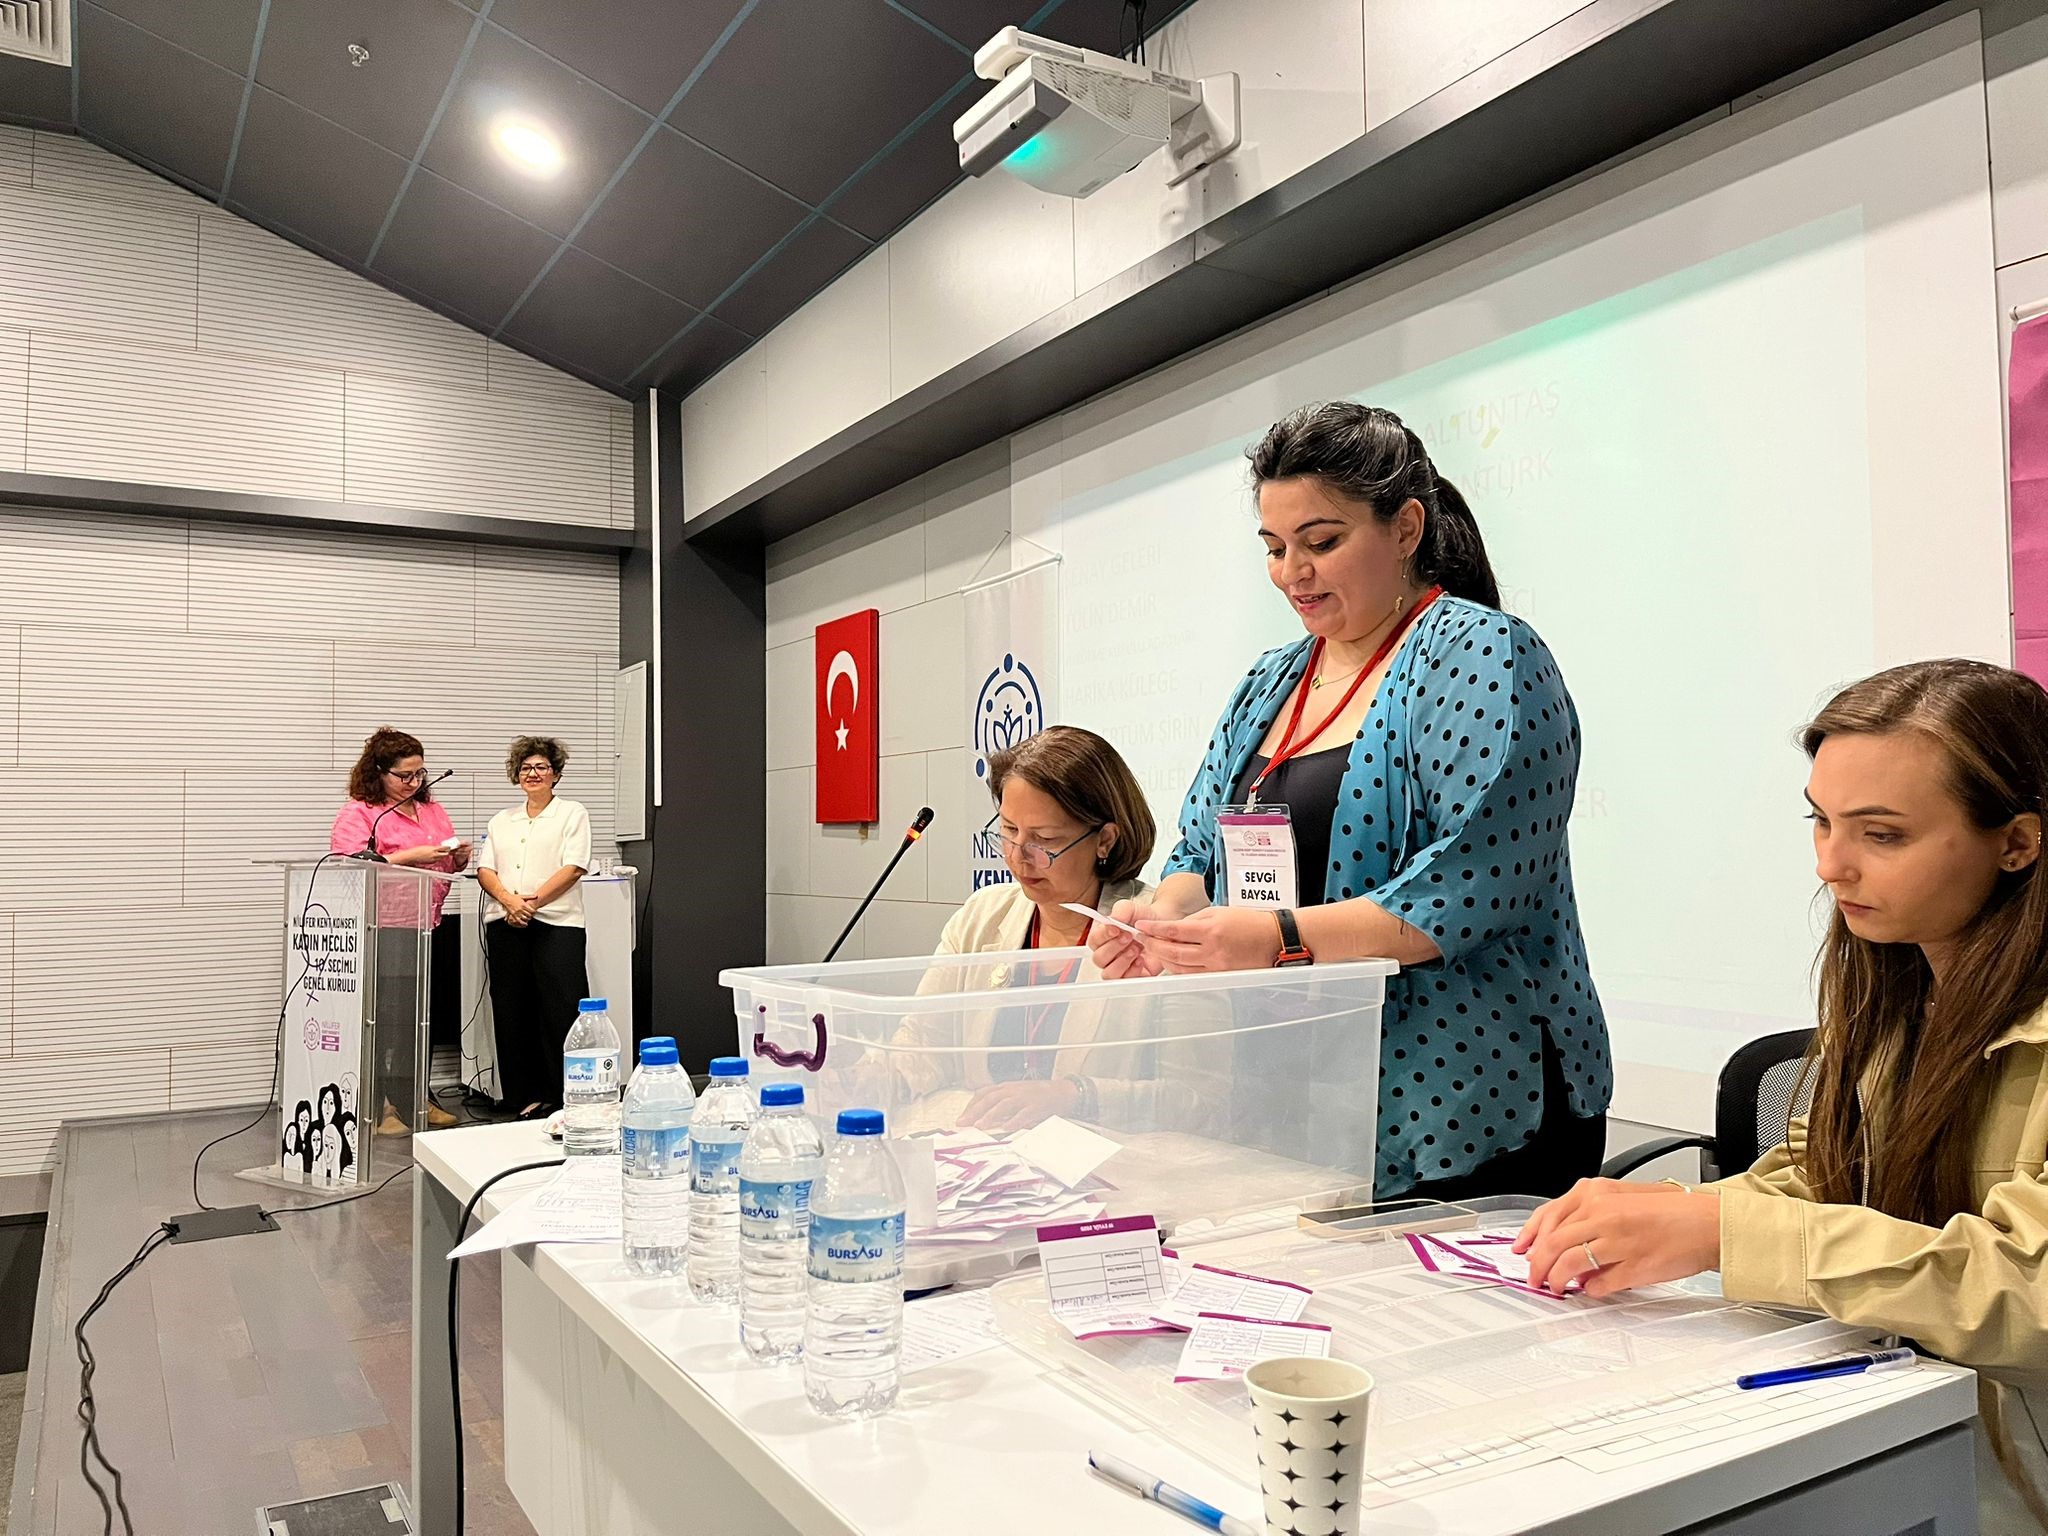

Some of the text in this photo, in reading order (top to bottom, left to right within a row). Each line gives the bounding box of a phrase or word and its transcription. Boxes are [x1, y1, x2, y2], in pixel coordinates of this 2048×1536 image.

[1245, 869, 1276, 883] SEVGİ
[1241, 889, 1281, 901] BAYSAL
[293, 915, 316, 928] NİLFER
[317, 917, 332, 928] KENT
[293, 931, 357, 953] KADIN MECLİSİ
[328, 956, 357, 976] SEÇİMLİ
[303, 975, 356, 993] GENEL KURULU
